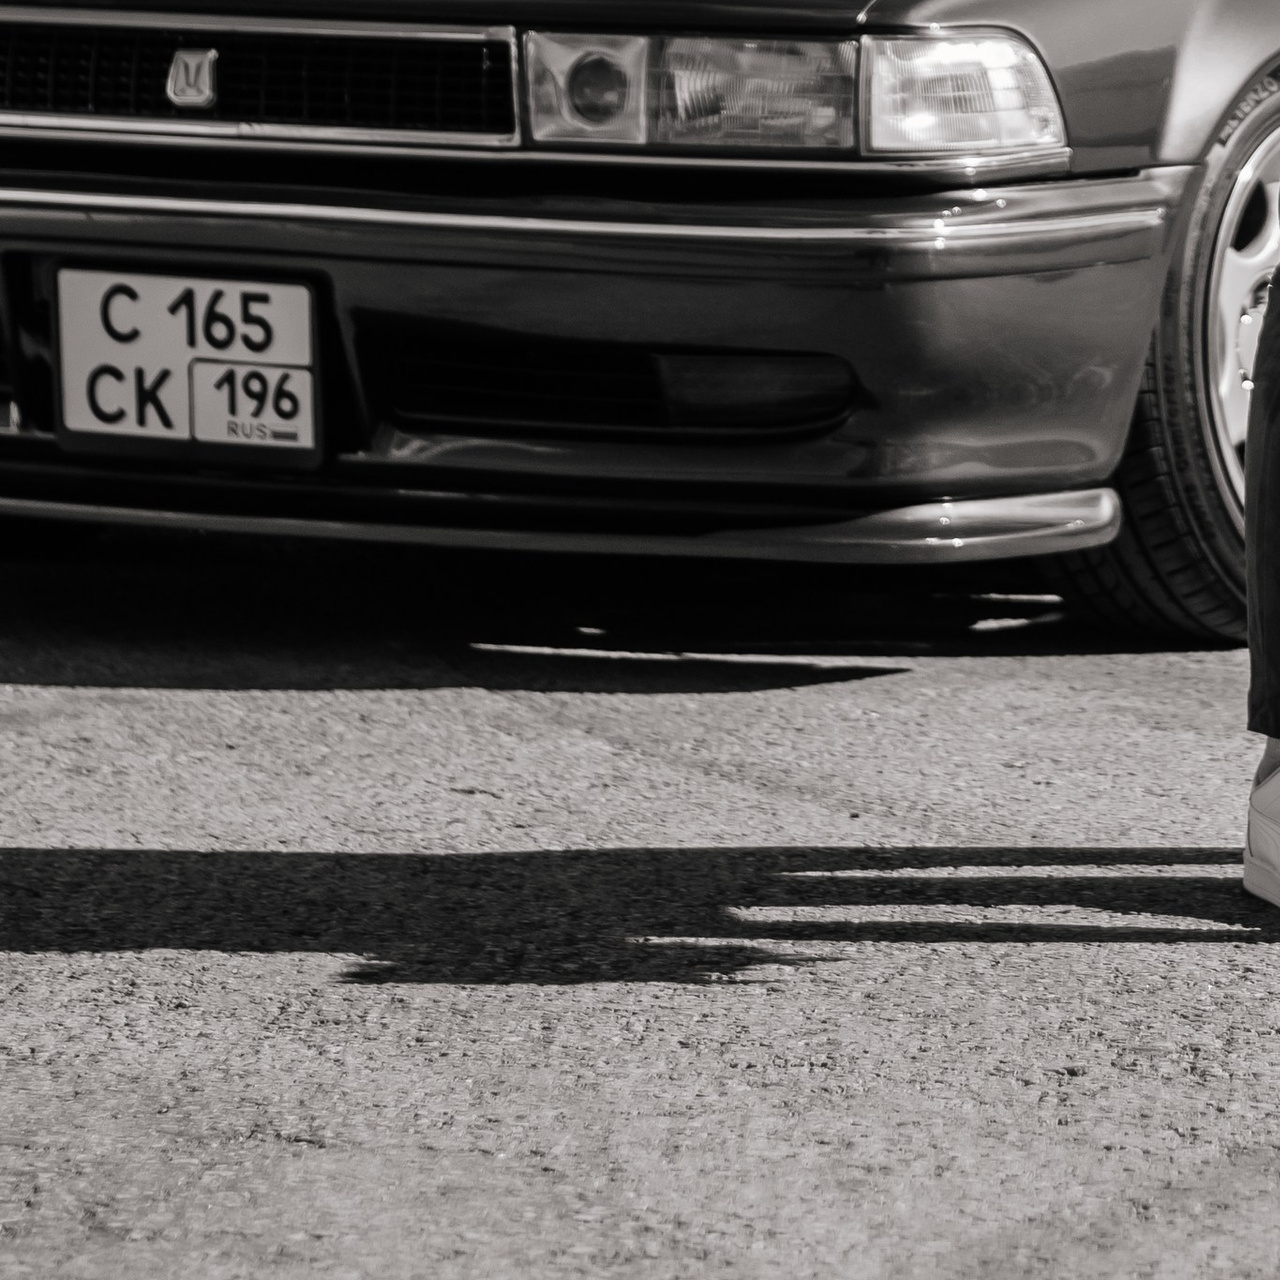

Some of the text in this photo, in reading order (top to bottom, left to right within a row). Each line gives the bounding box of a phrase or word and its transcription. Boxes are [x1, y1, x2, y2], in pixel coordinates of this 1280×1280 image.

[100, 283, 273, 353] C 165
[86, 364, 174, 430] CK
[213, 368, 300, 420] 196
[226, 420, 268, 440] RUS
